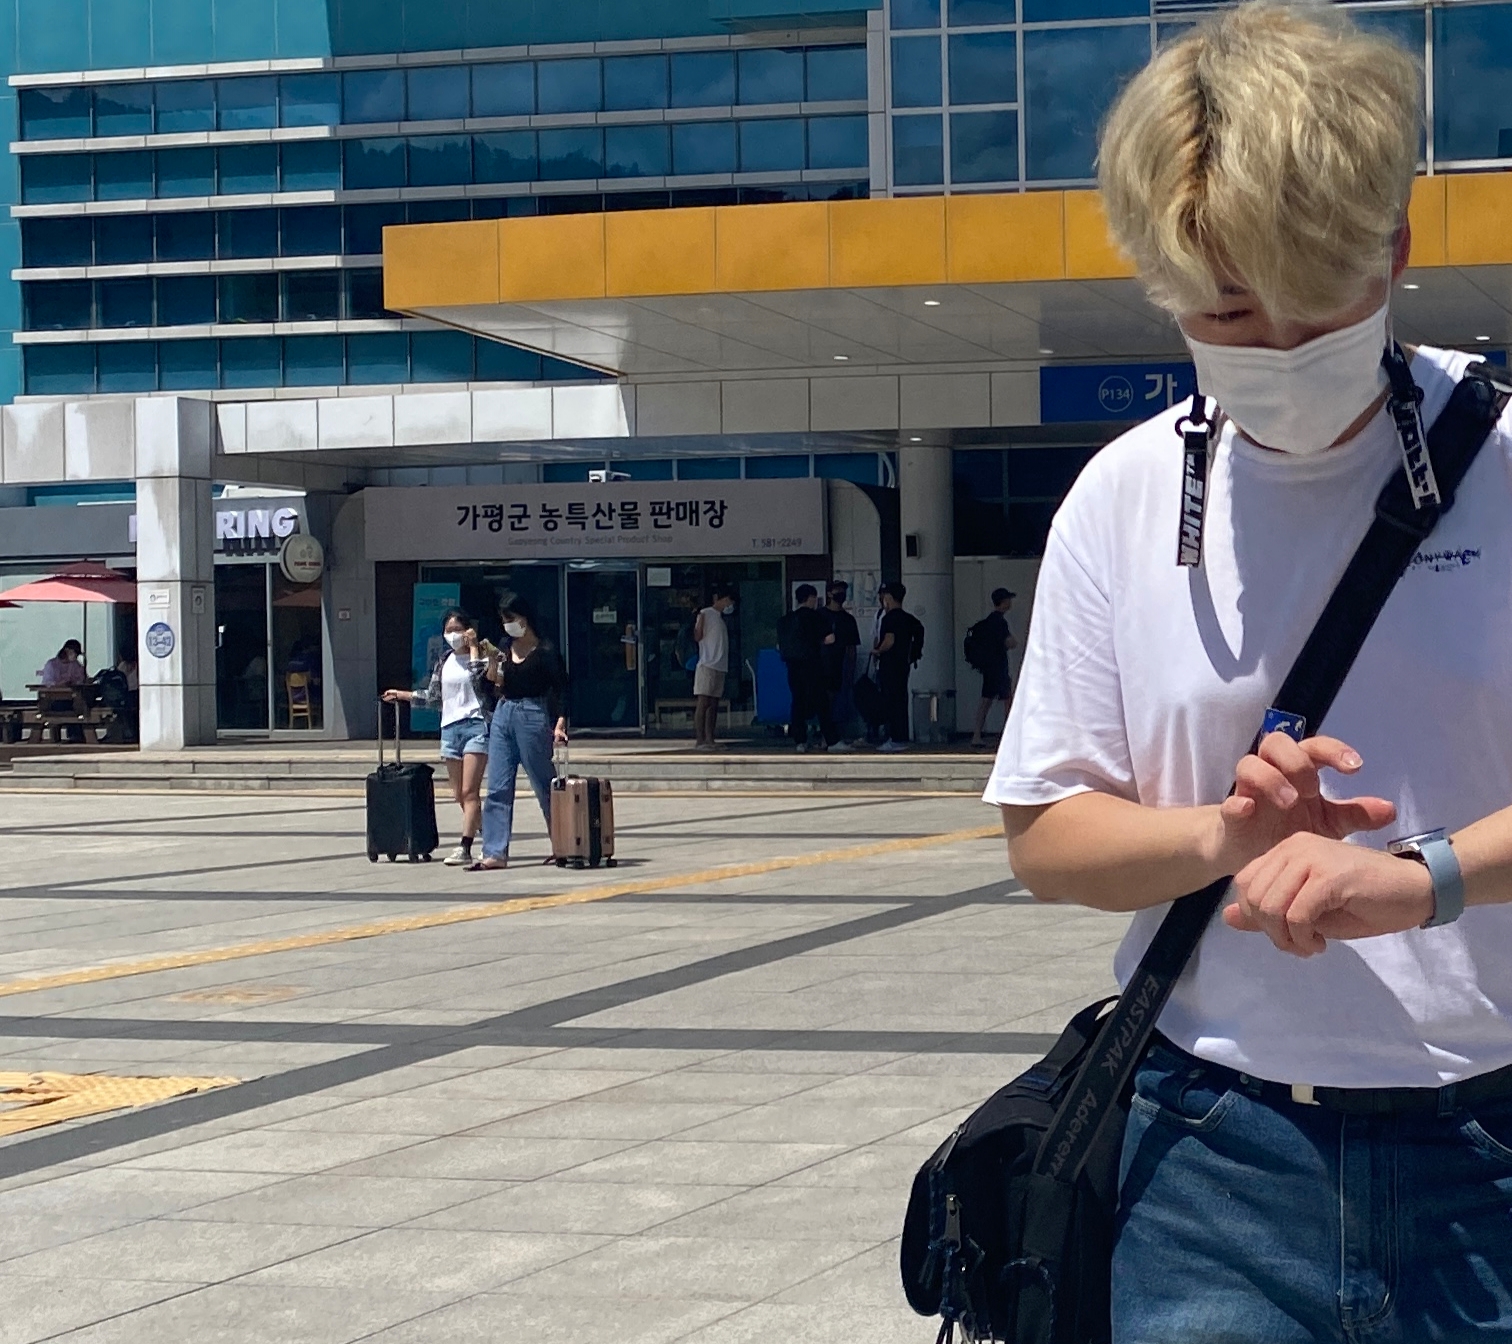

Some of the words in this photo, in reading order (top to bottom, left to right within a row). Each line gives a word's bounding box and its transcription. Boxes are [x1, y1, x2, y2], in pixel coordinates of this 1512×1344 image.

[1101, 389, 1131, 400] P134
[456, 504, 531, 532] 가평군
[539, 502, 641, 532] 농특산물
[649, 499, 728, 529] 판매장
[549, 535, 582, 546] Country
[584, 534, 615, 545] Special
[617, 533, 650, 544] Product
[652, 533, 673, 544] Shop
[1101, 974, 1160, 1077] EASTPAK
